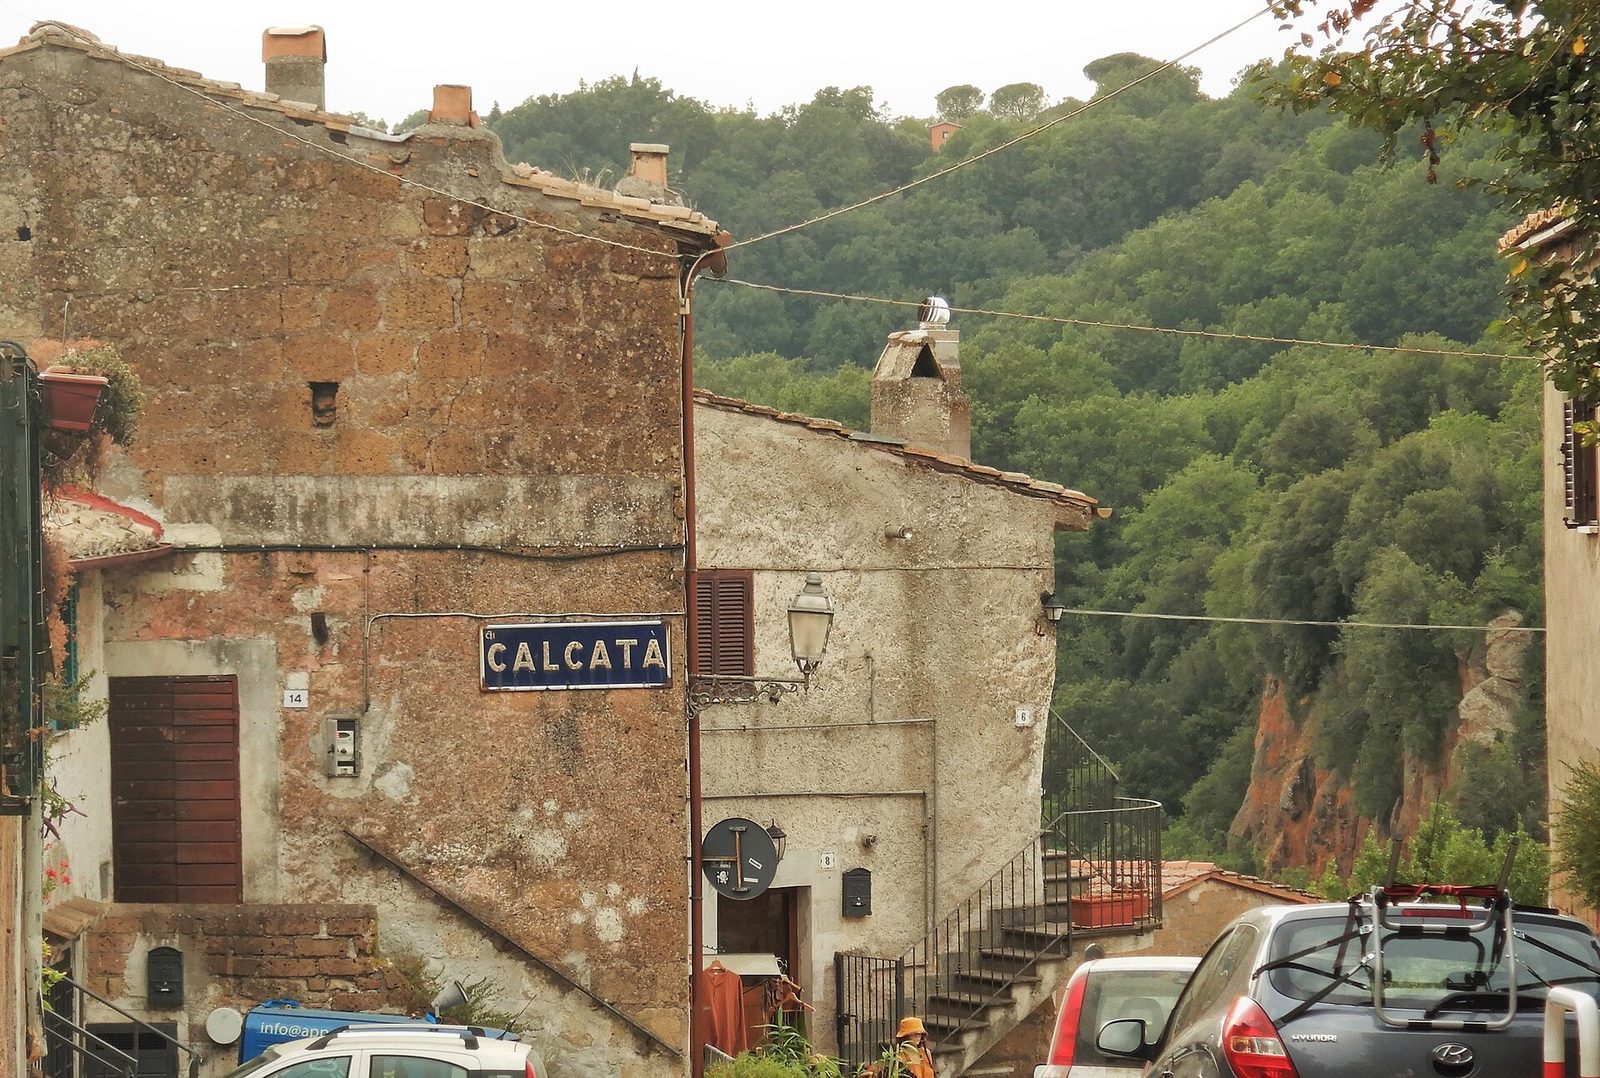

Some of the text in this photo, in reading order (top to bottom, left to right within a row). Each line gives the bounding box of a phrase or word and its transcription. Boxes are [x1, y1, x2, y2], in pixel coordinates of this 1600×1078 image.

[289, 694, 302, 703] 14
[1021, 712, 1027, 722] 6
[825, 856, 830, 866] 8
[1292, 1034, 1338, 1042] HYUNDAI
